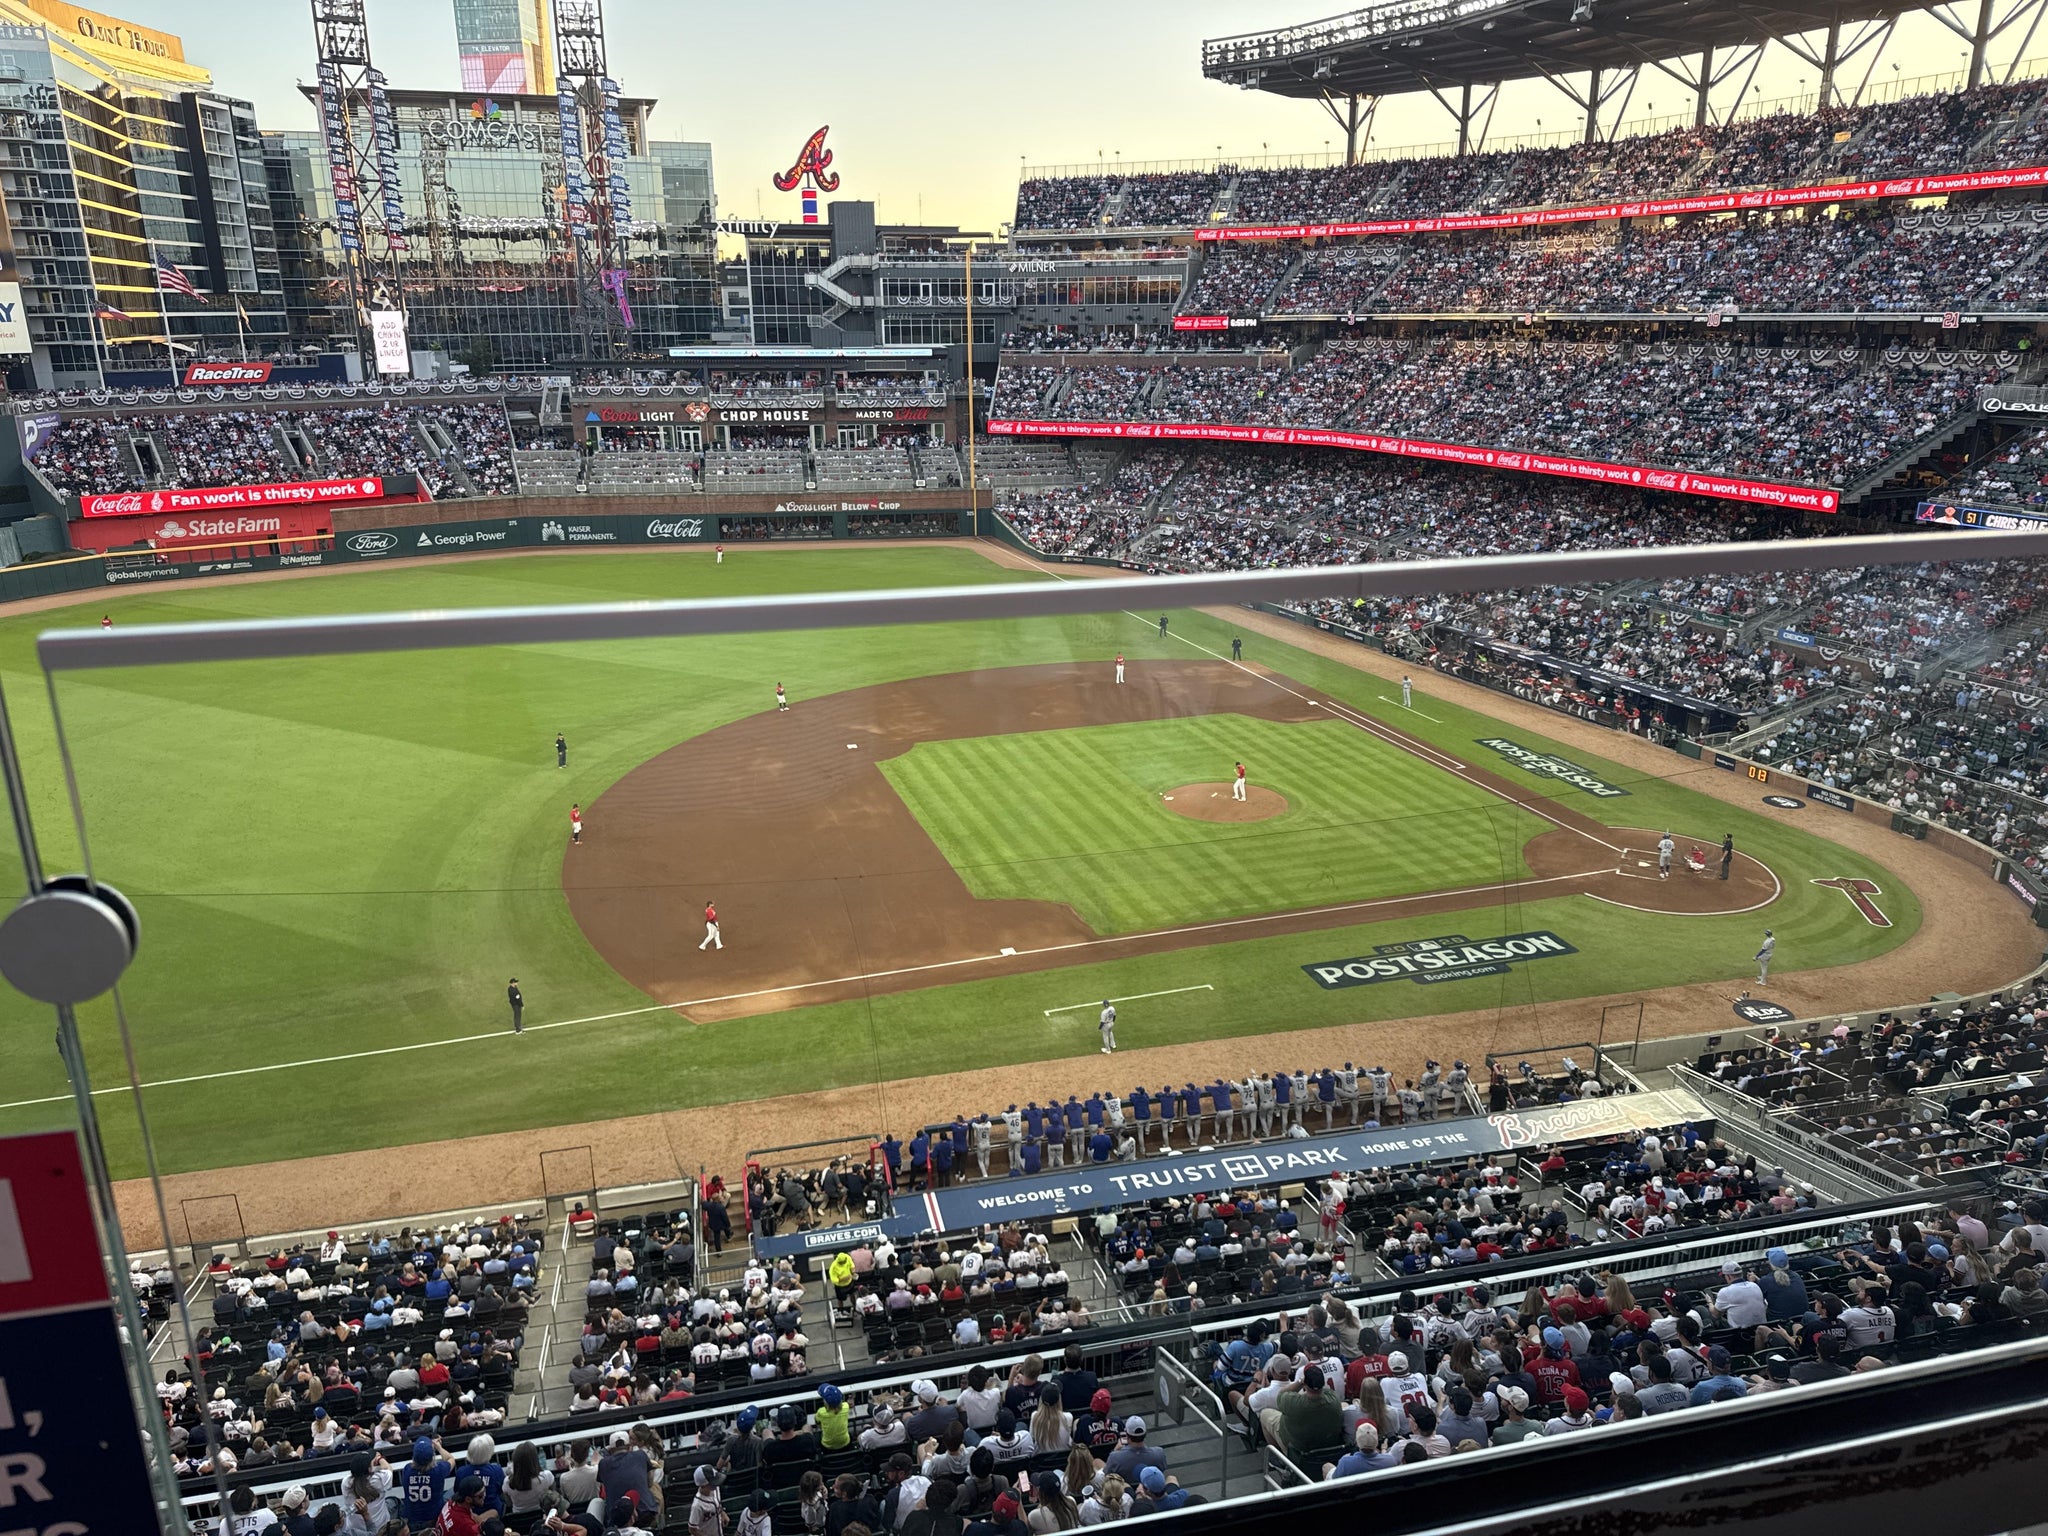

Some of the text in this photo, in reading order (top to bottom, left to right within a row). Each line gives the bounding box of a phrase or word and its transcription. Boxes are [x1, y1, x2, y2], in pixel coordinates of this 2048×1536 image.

[428, 120, 546, 141] COMCAST
[1884, 181, 1912, 193] Coca-Cola
[1927, 172, 2040, 189] Fan work is thirsty work
[1775, 187, 1866, 201] Fan work is thirsty work
[714, 213, 779, 238] xfinity
[1018, 262, 1056, 272] MILNER
[381, 322, 396, 330] ADD
[1707, 313, 1720, 326] 10
[1942, 312, 1960, 328] 21
[383, 340, 388, 348] 2
[191, 367, 264, 380] RaceTrac
[601, 407, 674, 422] Coors LIGHT
[720, 410, 810, 421] CHOP HOUSE
[855, 411, 880, 419] MADE
[895, 407, 932, 421] Chill
[1067, 425, 1091, 435] thirsty
[1209, 428, 1231, 438] thirsty
[1231, 430, 1250, 438] work
[1497, 455, 1522, 467] Coca-Cola
[1533, 459, 1629, 481] Fan work is thirsty work
[1646, 472, 1676, 488] Coca-Cola
[171, 483, 357, 506] Fan work is thirsty work
[1691, 479, 1818, 505] Fan work is thirsty work
[91, 495, 143, 513] Coca-Cola
[786, 501, 813, 512] Coors
[841, 502, 869, 510] BELOW
[878, 502, 900, 510] CHOP
[646, 518, 704, 538] Coca-Cola
[1966, 512, 2048, 531] 51 CHRIS SALE
[355, 535, 389, 550] Ford
[434, 531, 507, 545] Georgia Power
[290, 554, 322, 563] National
[106, 567, 179, 582] globalpayments
[1783, 632, 1809, 643] GEICO
[1483, 739, 1622, 796] POSTSEASON
[1749, 766, 1767, 782] 0 13
[1813, 792, 1847, 808] LIKE OCTOBER
[1829, 792, 1841, 800] TIME
[2009, 873, 2037, 905] Booking.com
[1314, 935, 1566, 984] POSTSEASON
[1423, 965, 1496, 982] Booking.com
[1743, 1007, 1783, 1017] NLDS
[1297, 1082, 1304, 1091] 13
[1376, 1081, 1385, 1089] 30
[1110, 1104, 1120, 1113] 95
[1010, 1119, 1019, 1127] 46
[1488, 1101, 1620, 1149] Braves
[1361, 1133, 1468, 1155] HOME OF THE
[1109, 1147, 1349, 1196] TRUIST PARK
[978, 1184, 1093, 1209] WELCOME TO
[809, 1227, 879, 1244] BRAVES.COM
[322, 1248, 334, 1259] 27
[965, 1259, 974, 1268] 18
[748, 1278, 761, 1288] 99
[1364, 1362, 1384, 1372] RILEY
[1538, 1366, 1569, 1377] ACUÑA JR
[1543, 1376, 1565, 1395] 13
[1655, 1392, 1687, 1406] ROBINSON
[999, 1447, 1022, 1459] RILEY
[409, 1476, 431, 1484] BETTS
[408, 1486, 431, 1502] 50
